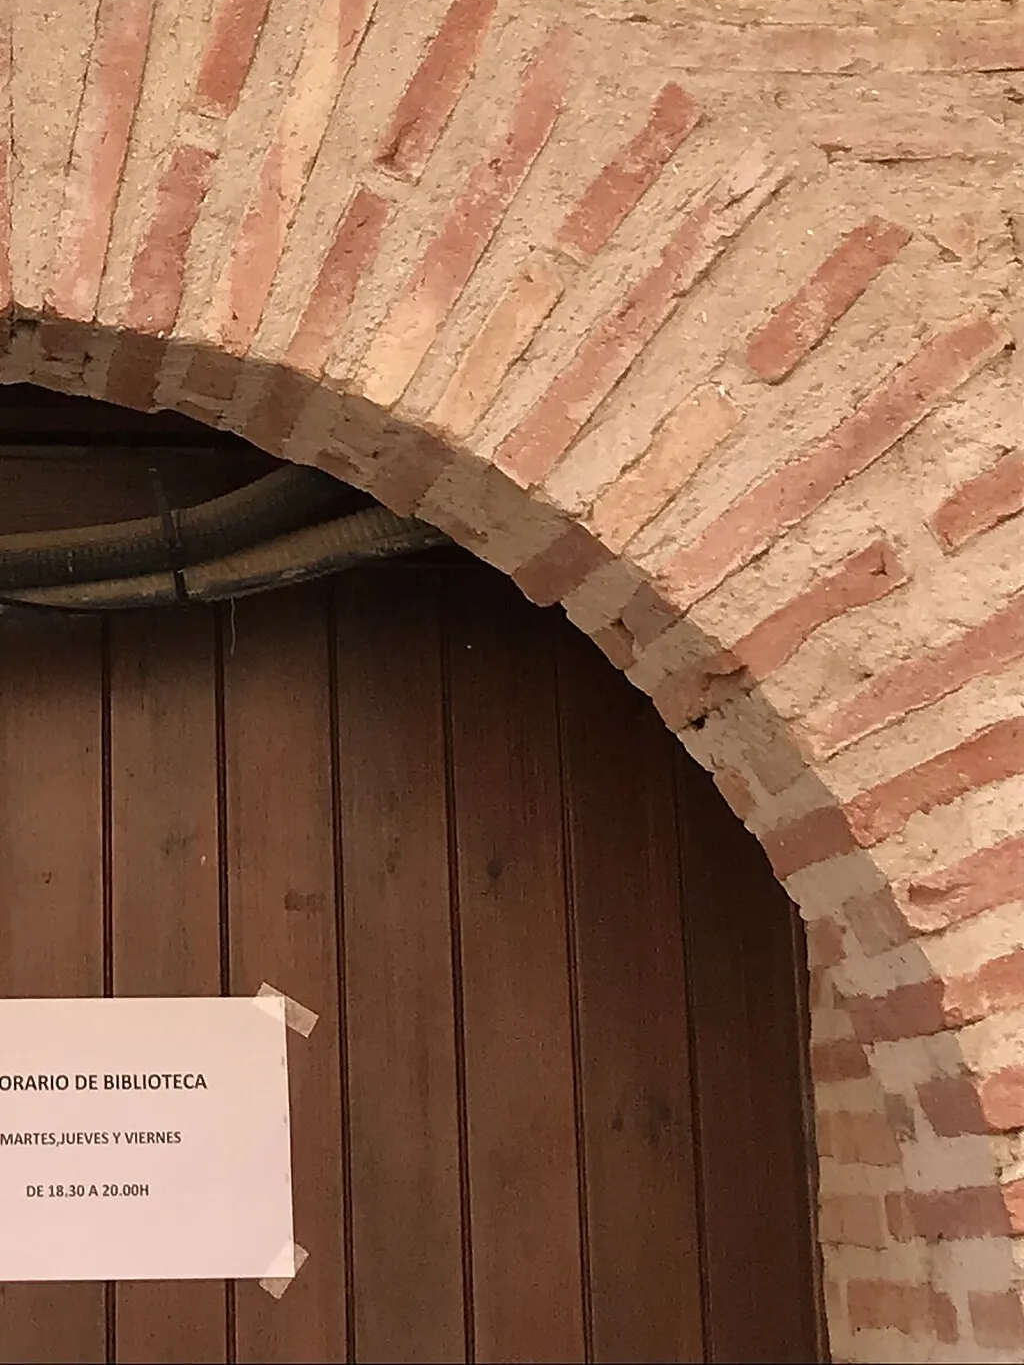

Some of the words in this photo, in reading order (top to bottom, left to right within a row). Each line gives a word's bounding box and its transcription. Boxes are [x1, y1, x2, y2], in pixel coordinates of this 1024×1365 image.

[75, 1074, 99, 1091] DE
[103, 1073, 208, 1091] BIBLIOTECA
[112, 1131, 122, 1145] Y
[124, 1131, 182, 1145] VIERNES
[26, 1184, 44, 1198] DE
[48, 1184, 85, 1198] 18.30
[88, 1184, 99, 1197] A
[102, 1183, 150, 1197] 20.00H
